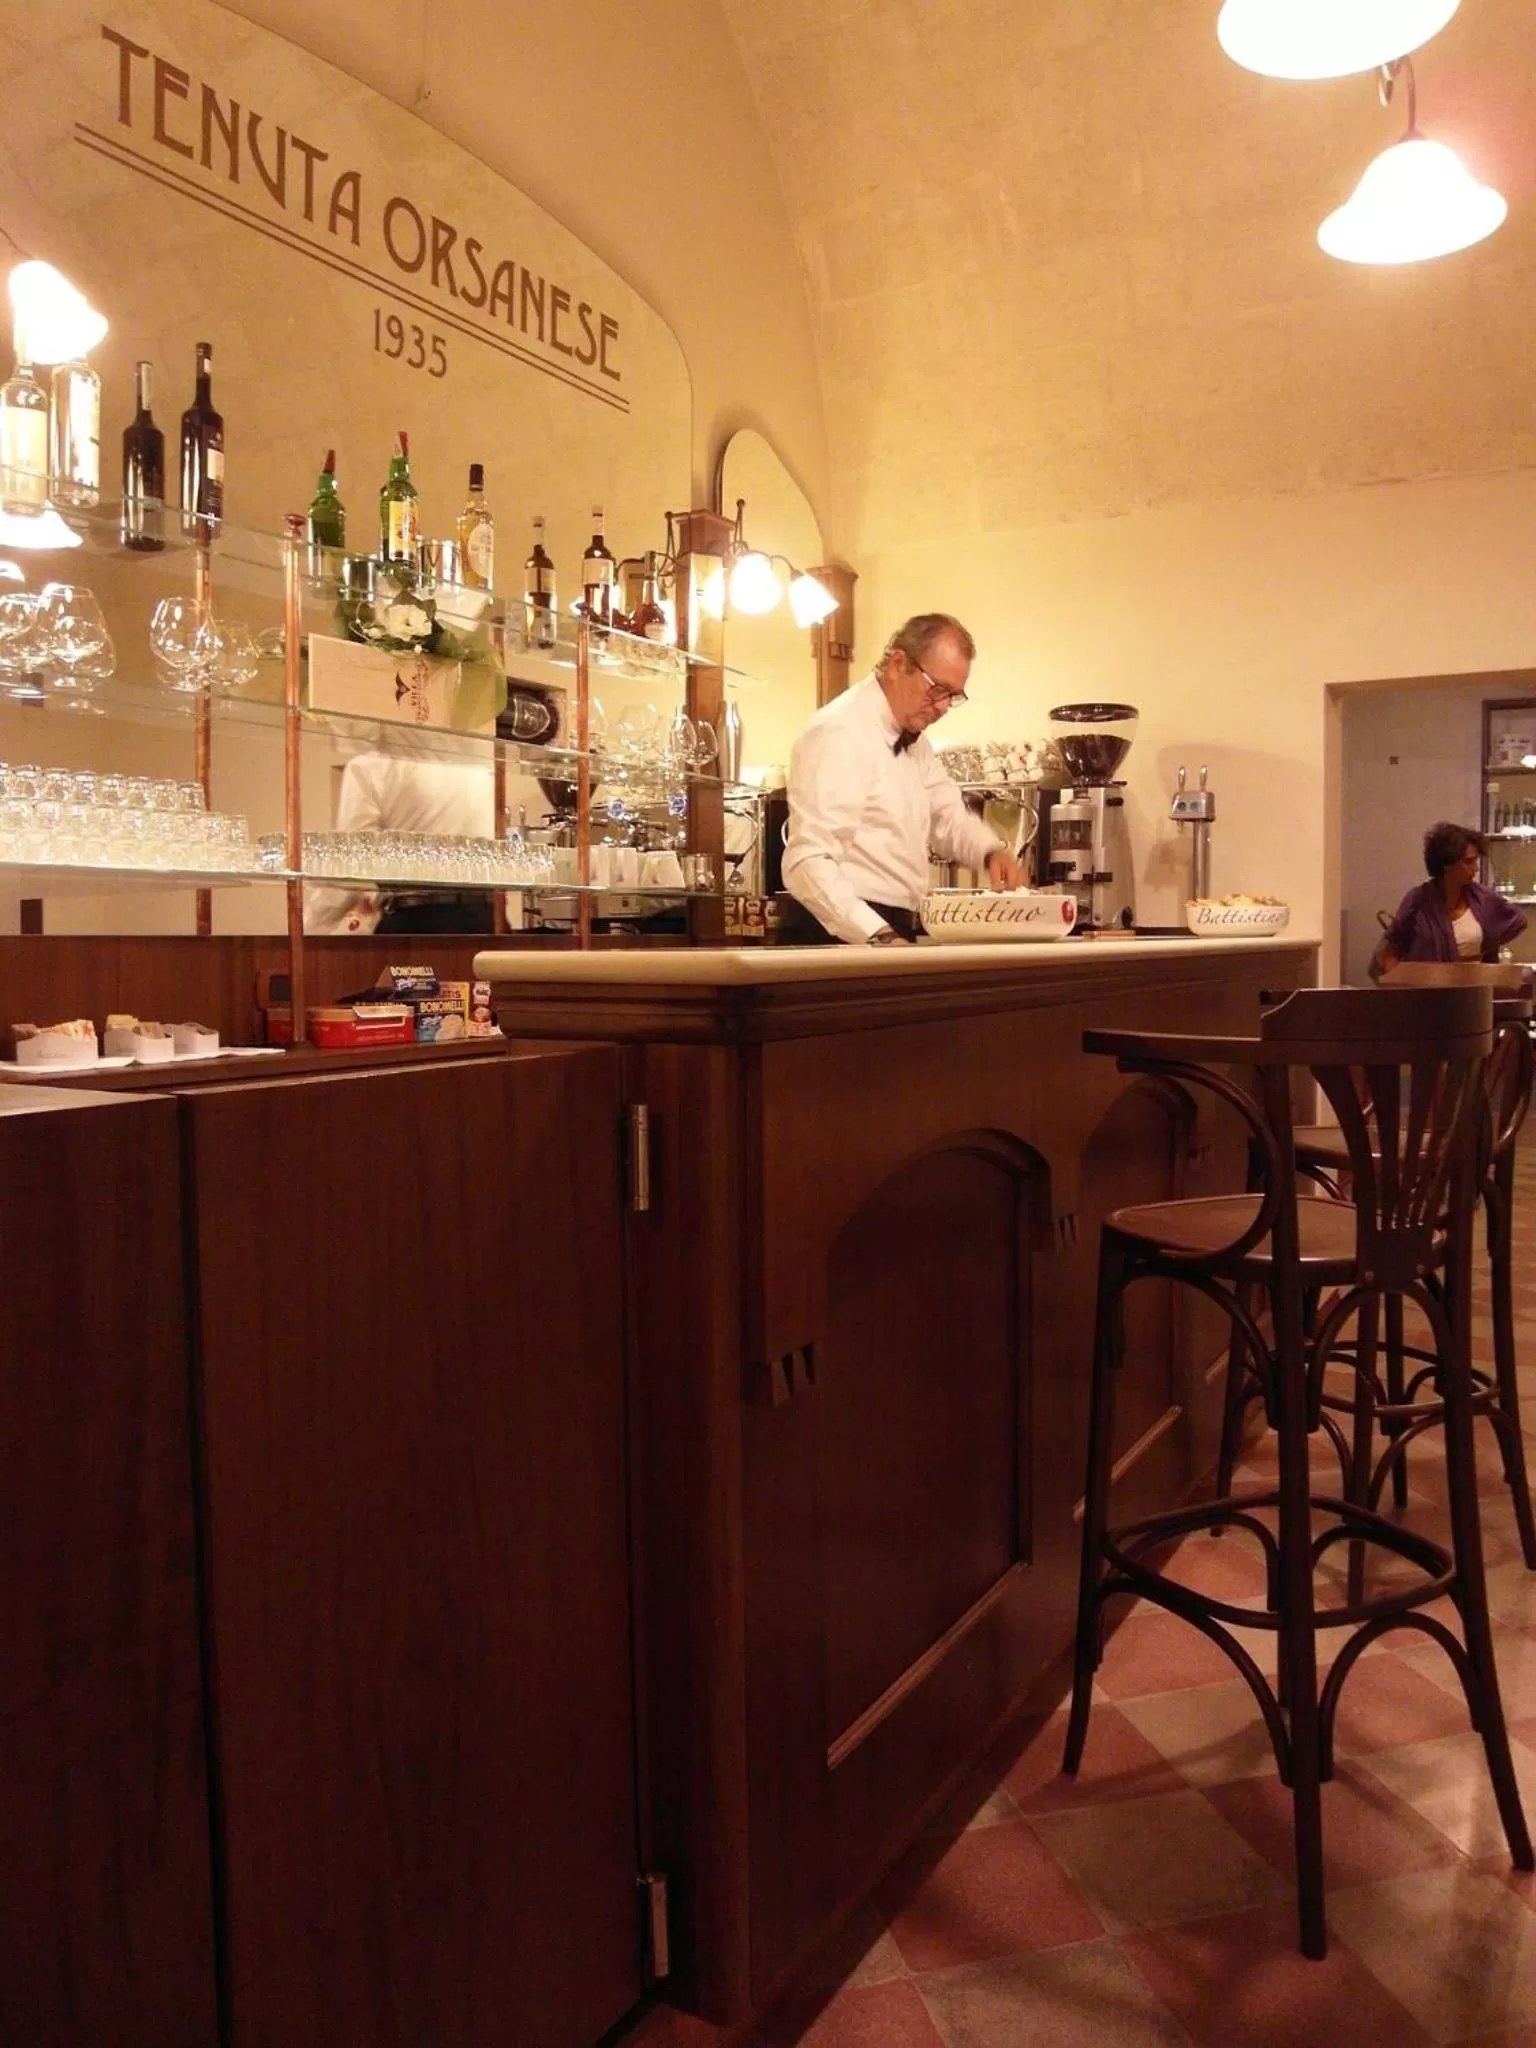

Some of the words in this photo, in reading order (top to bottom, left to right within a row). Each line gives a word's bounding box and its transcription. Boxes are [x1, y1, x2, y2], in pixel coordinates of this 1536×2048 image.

[101, 24, 362, 246] TENUTA
[382, 196, 621, 382] ORSANESE
[372, 307, 449, 378] 1935
